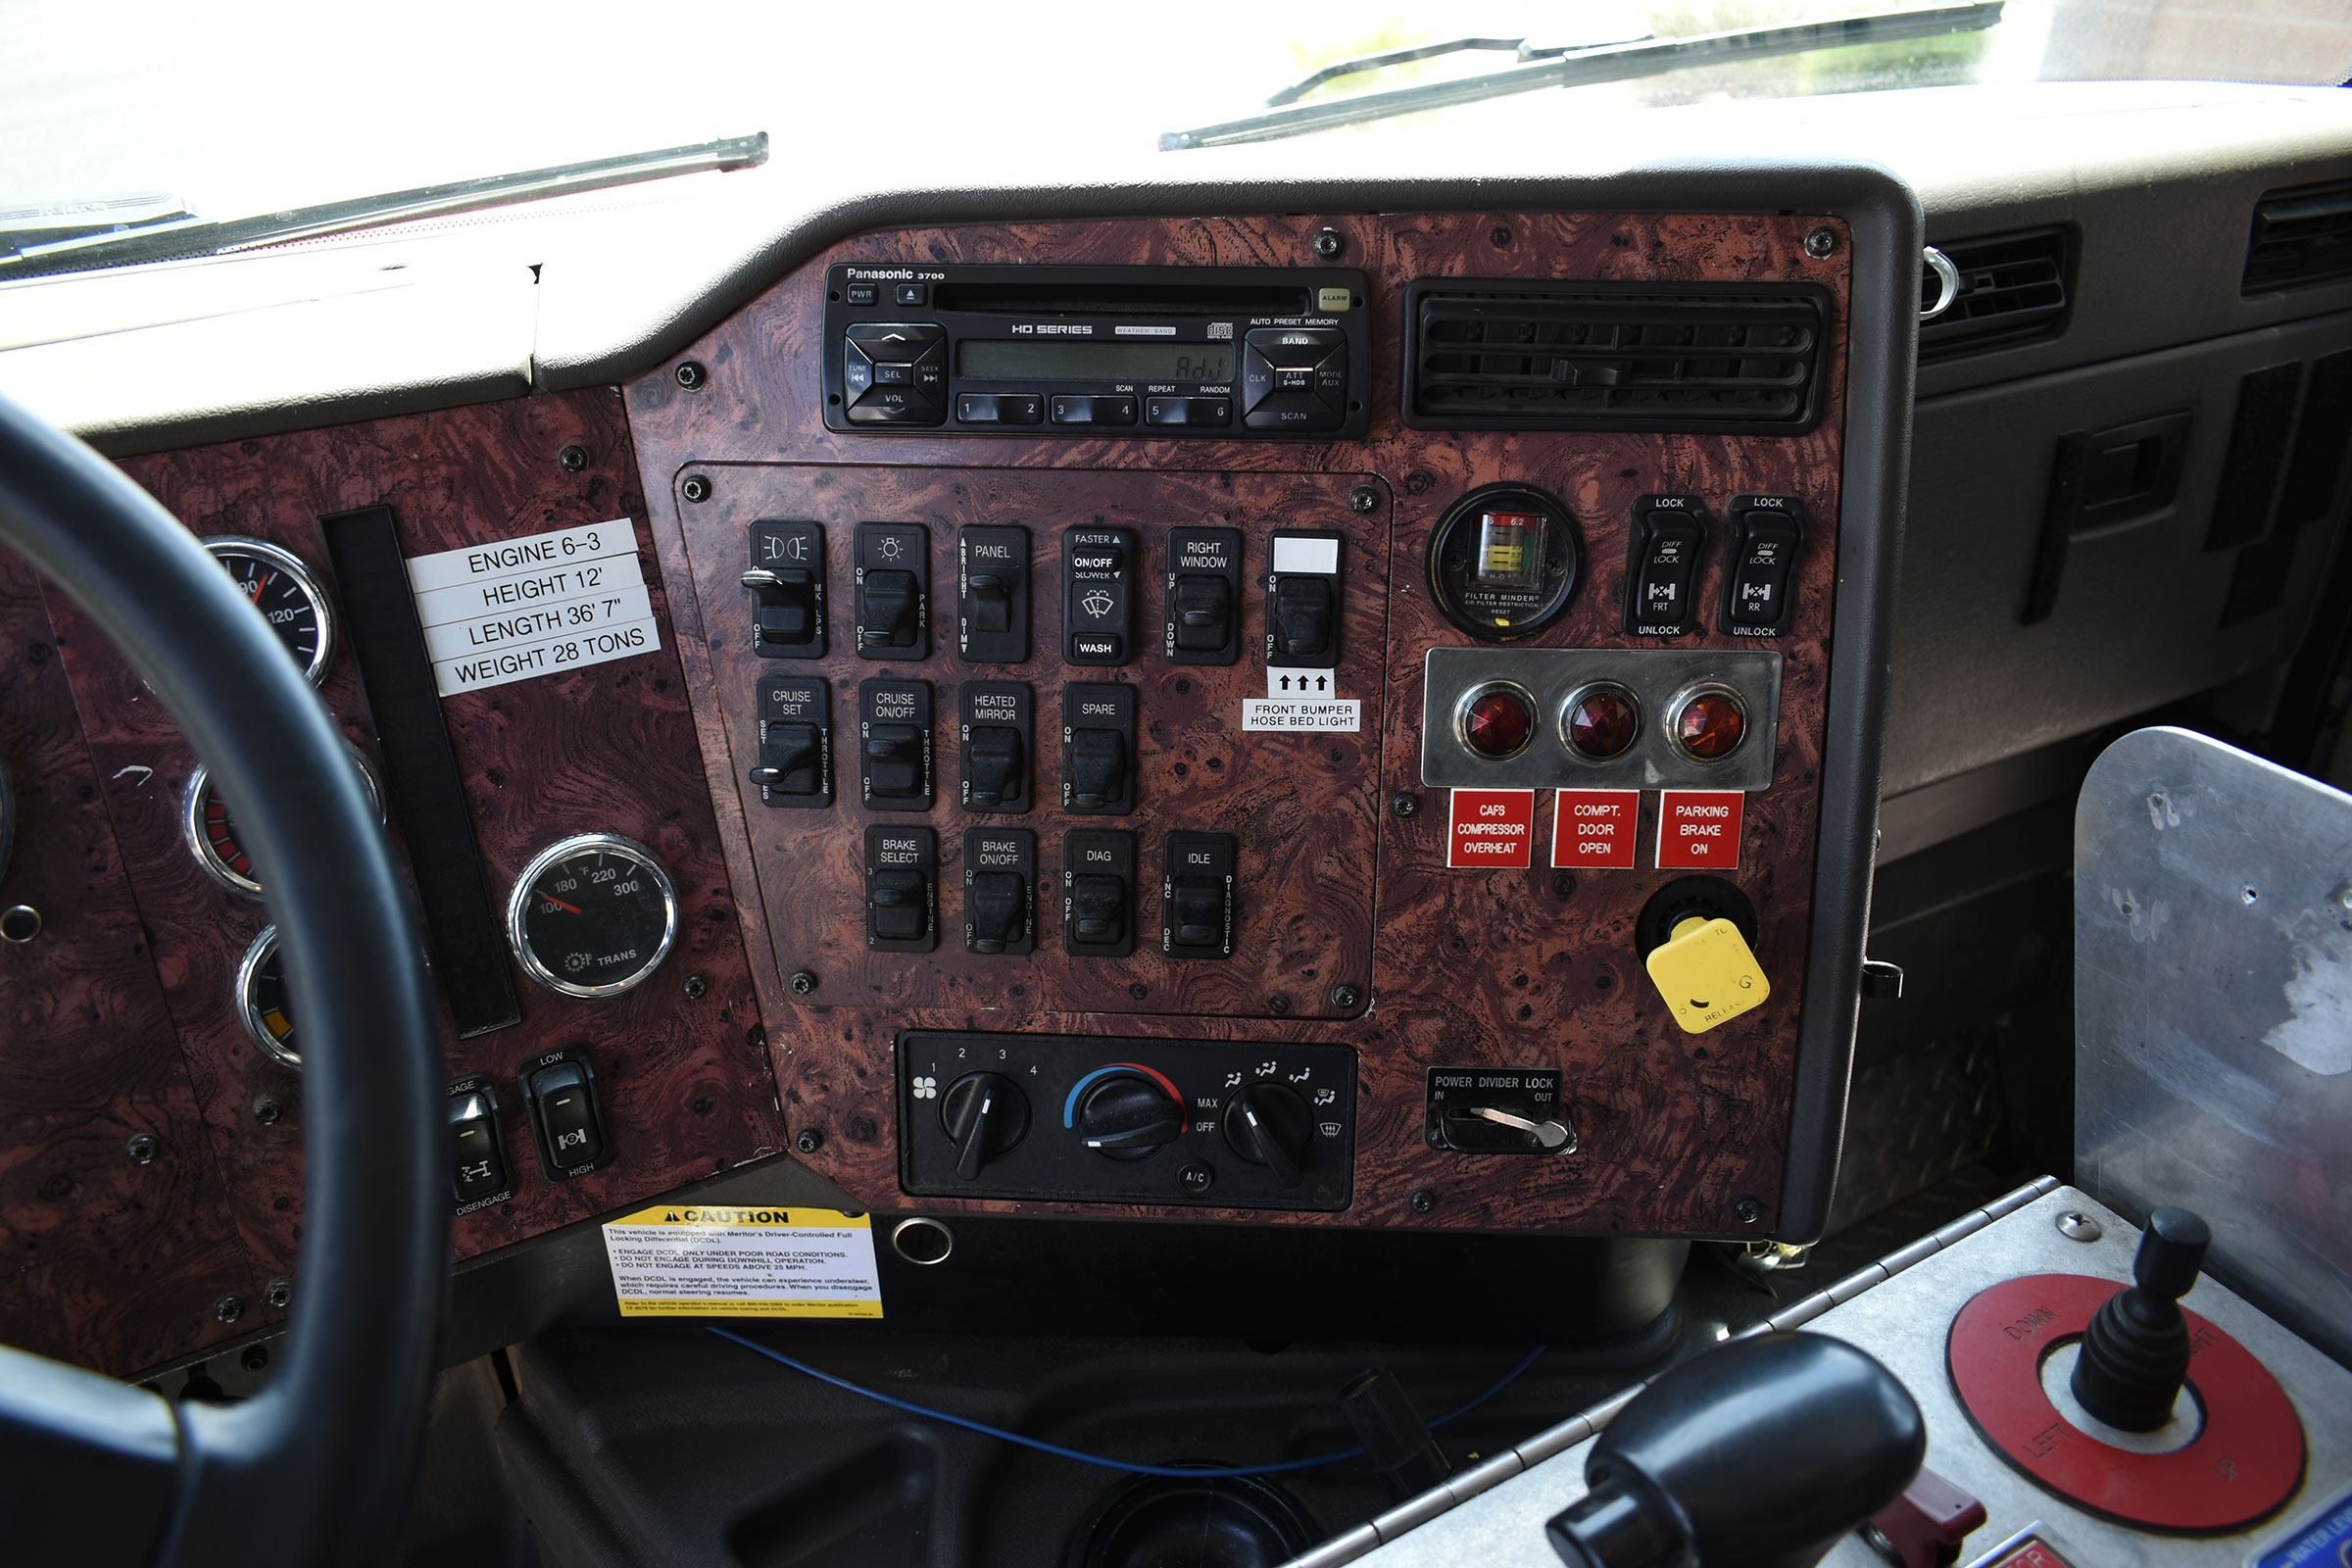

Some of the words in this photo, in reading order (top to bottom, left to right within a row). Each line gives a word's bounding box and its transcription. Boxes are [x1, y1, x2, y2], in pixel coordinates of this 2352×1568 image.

[847, 269, 913, 280] Panasonic
[1011, 324, 1033, 334] HD
[1036, 324, 1093, 334] SERIES
[885, 394, 904, 403] VOL
[1655, 498, 1685, 508] LOCK
[1753, 498, 1784, 508] LOCK
[1075, 535, 1109, 544] FASTER
[467, 540, 558, 573] ENGINE
[562, 532, 601, 556] 6-3
[975, 545, 1010, 559] PANEL
[1187, 542, 1221, 555] RIGHT
[1074, 557, 1112, 567] ON/OFF
[1180, 556, 1228, 568] WINDOW
[856, 567, 863, 585] ON
[482, 573, 567, 607] HEIGHT
[575, 567, 603, 588] 12'
[1269, 575, 1276, 592] ON
[1653, 602, 1668, 612] FRT
[1748, 603, 1760, 612] RR
[268, 608, 294, 624] 120
[468, 610, 563, 646] LENGTH
[567, 604, 596, 625] 36'
[601, 598, 621, 617] 7"
[1639, 625, 1681, 635] UNLOCK
[1733, 626, 1776, 636] UNLOCK
[1079, 643, 1111, 653] WASH
[455, 648, 546, 683] WEIGHT
[553, 642, 579, 663] 28
[583, 628, 645, 656] TONS
[772, 690, 811, 703] CRUISE
[876, 693, 914, 705] CRUISE
[974, 695, 1016, 707] HEATED
[782, 705, 803, 715] SET
[875, 706, 915, 718] ON/OFF
[974, 709, 1015, 720] MIRROR
[1082, 704, 1116, 715] SPARE
[1255, 705, 1296, 714] FRONT
[1300, 706, 1352, 715] BUMPER
[1250, 716, 1285, 726] HOSE
[1290, 716, 1314, 726] BED
[1318, 716, 1355, 726] LIGHT
[861, 721, 869, 738] ON
[962, 724, 969, 741] ON
[1064, 726, 1071, 743] ON
[1479, 805, 1506, 817] CAFS
[1574, 805, 1621, 817] COMPT.
[1676, 806, 1730, 817] PARKING
[1457, 823, 1525, 835] COMPRESSOR
[1578, 823, 1614, 835] DOOR
[1680, 824, 1722, 836] BRAKE
[882, 839, 917, 851] BRAKE
[982, 841, 1016, 853] BRAKE
[1463, 842, 1517, 854] OVERHEAT
[1578, 843, 1611, 855] OPEN
[1690, 843, 1708, 855] ON
[880, 853, 919, 863] SELECT
[979, 854, 1019, 865] ON/OFF
[1086, 850, 1111, 861] DIAG
[1188, 853, 1211, 864] IDLE
[591, 868, 616, 884] 220
[554, 878, 577, 894] 180
[612, 880, 639, 897] 300
[539, 902, 564, 914] 100
[1223, 874, 1232, 954] DIAGNOSTIC
[597, 949, 637, 967] TRANS
[540, 1052, 564, 1066] LOW
[958, 1048, 966, 1058] 2
[999, 1049, 1006, 1059] 3
[1030, 1065, 1038, 1075] 4
[1435, 1076, 1472, 1088] POWER
[1479, 1077, 1519, 1088] DIVIDER
[1525, 1078, 1553, 1089] LOCK
[1434, 1091, 1445, 1101] IN
[1534, 1092, 1552, 1102] OUT
[1197, 1098, 1218, 1108] MAX
[1196, 1122, 1215, 1132] OFF
[568, 1163, 595, 1178] HIGH
[1186, 1171, 1204, 1183] A/C
[456, 1190, 512, 1216] DISENGAGE
[683, 1209, 790, 1224] CAUTION
[610, 1235, 642, 1244] Locking
[2003, 1305, 2057, 1341] DOWN
[2022, 1423, 2072, 1459] LEFT
[2286, 1528, 2331, 1564] WATER
